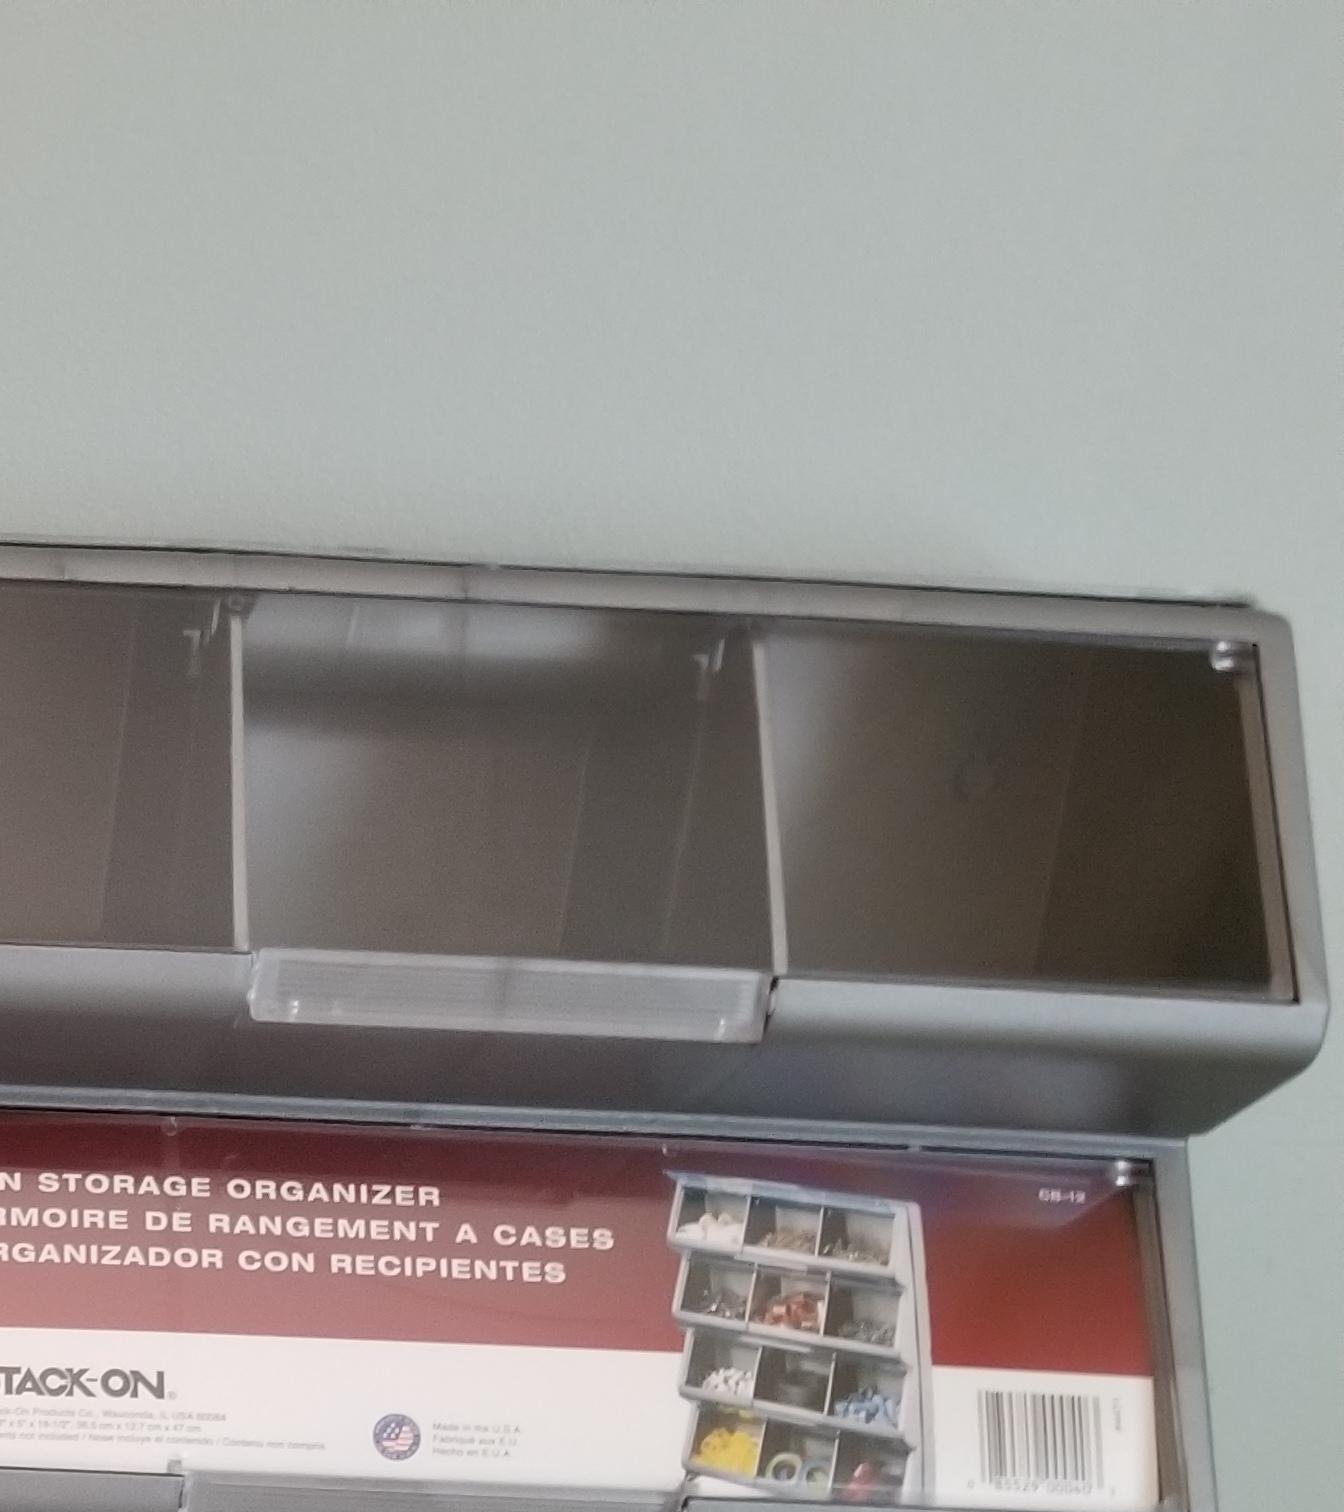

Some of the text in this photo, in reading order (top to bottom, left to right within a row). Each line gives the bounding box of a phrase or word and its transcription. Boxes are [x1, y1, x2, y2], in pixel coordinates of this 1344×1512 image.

[38, 1173, 211, 1197] STORAGE
[227, 1179, 440, 1206] ORGANIZER
[145, 1211, 192, 1232] DE
[209, 1214, 440, 1241] RANGEMENT
[493, 1225, 614, 1250] CASES
[238, 1250, 315, 1272] CON
[330, 1254, 566, 1283] RECIPIENTES
